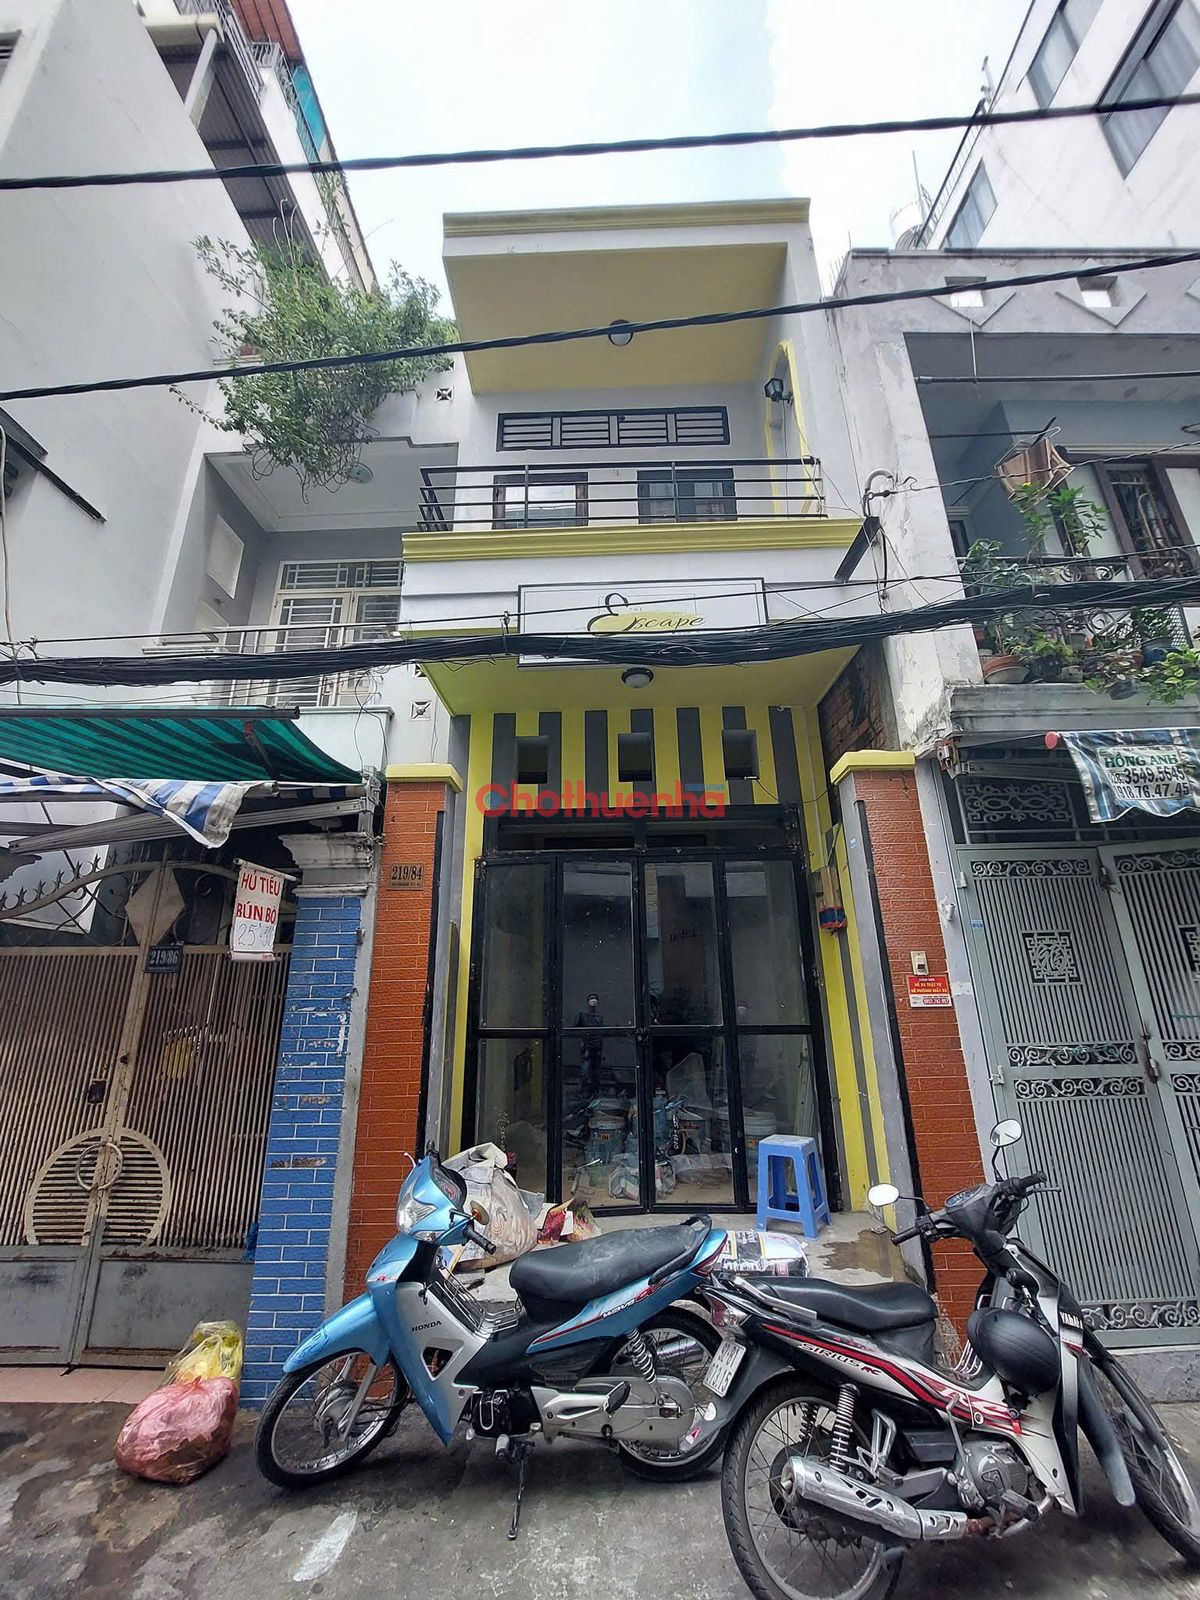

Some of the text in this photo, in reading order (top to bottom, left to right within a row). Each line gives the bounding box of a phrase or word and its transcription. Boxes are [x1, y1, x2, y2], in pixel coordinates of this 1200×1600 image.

[587, 592, 705, 636] Escape
[1150, 754, 1179, 766] ANH
[391, 865, 423, 881] 219/84
[236, 900, 263, 922] BÚN
[411, 1320, 443, 1333] HONDA
[801, 1342, 861, 1368] SIRIUS
